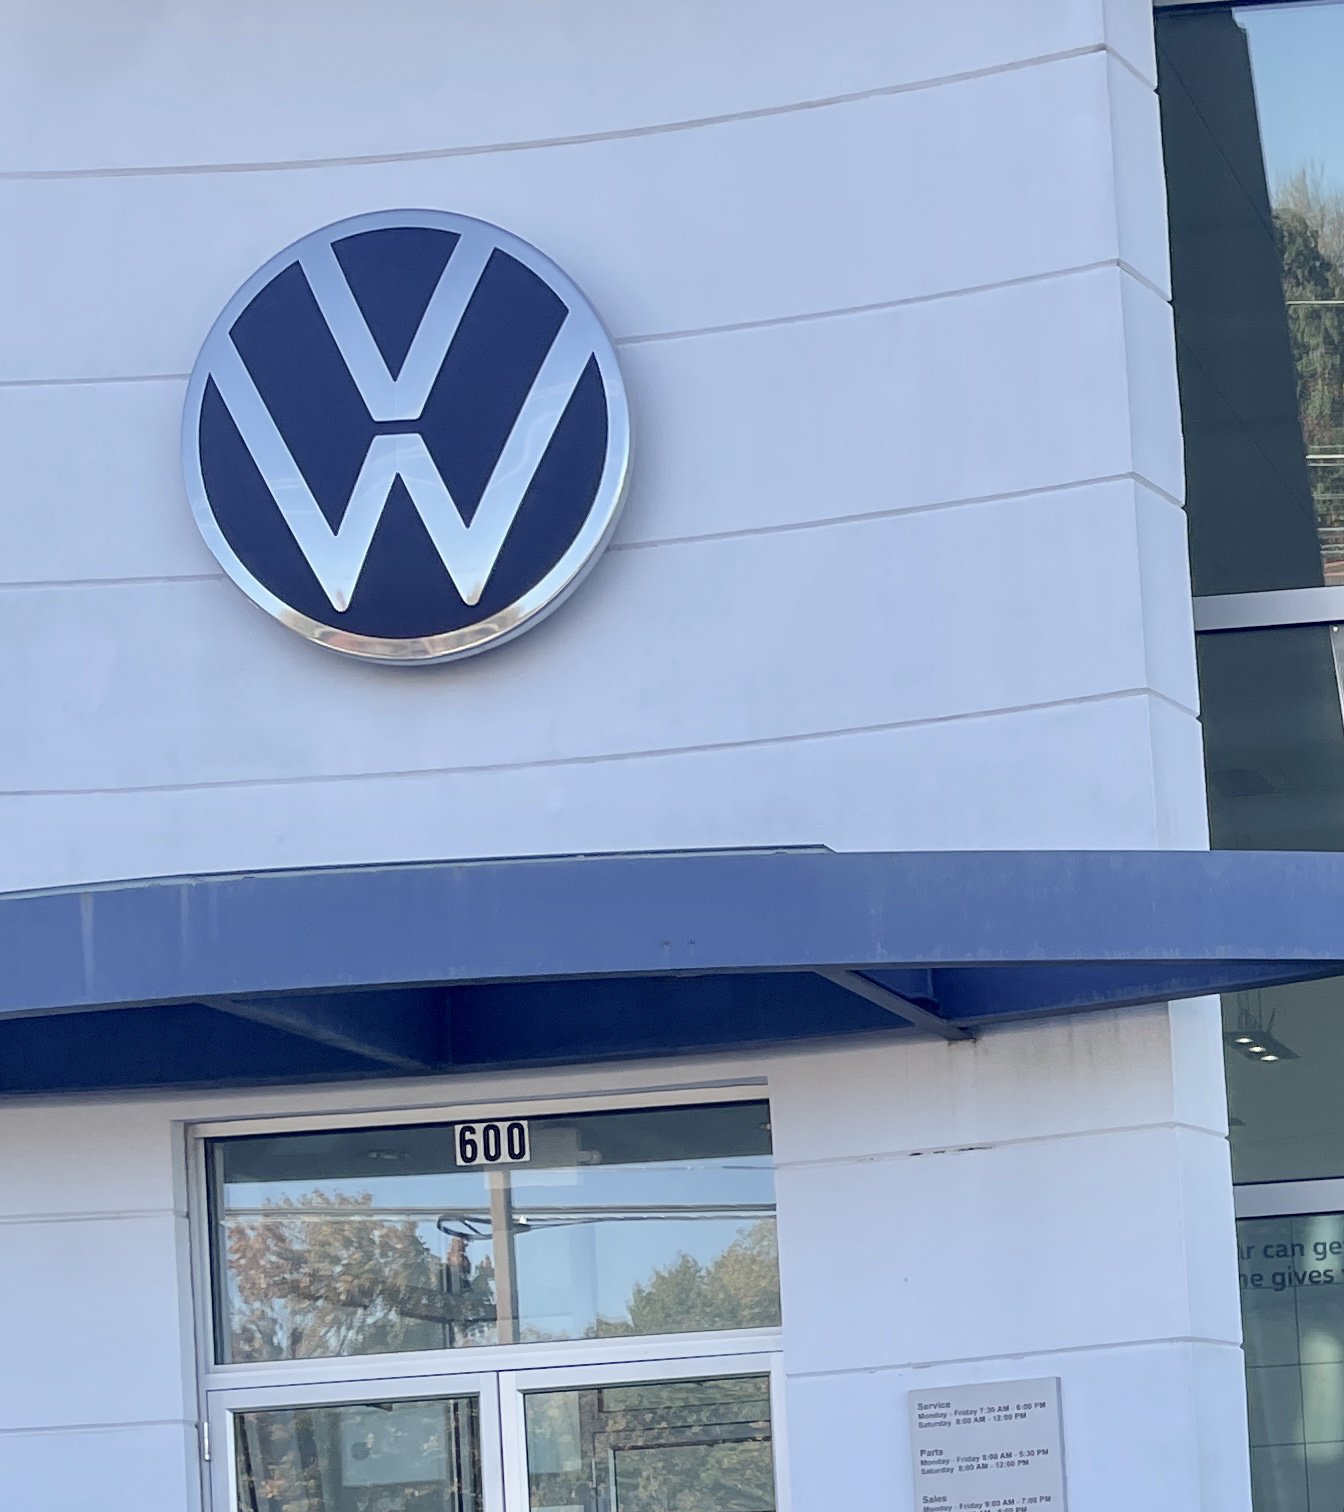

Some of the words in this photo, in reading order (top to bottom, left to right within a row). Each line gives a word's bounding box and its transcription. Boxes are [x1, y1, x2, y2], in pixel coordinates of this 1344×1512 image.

[459, 1122, 526, 1163] 600
[1263, 1241, 1305, 1259] can
[1272, 1265, 1334, 1292] gives
[917, 1401, 951, 1411] Service
[918, 1412, 947, 1420] Monday
[997, 1404, 1010, 1412] AM
[1034, 1401, 1046, 1409] PM
[918, 1420, 952, 1428] Saturday
[1015, 1412, 1027, 1420] PM
[920, 1448, 944, 1457] Parts
[921, 1467, 955, 1475] Saturday
[922, 1495, 947, 1504] Sales
[923, 1505, 953, 1512] Monday
[959, 1502, 983, 1510] Friday
[1002, 1498, 1015, 1506] AM
[1039, 1495, 1052, 1503] PM
